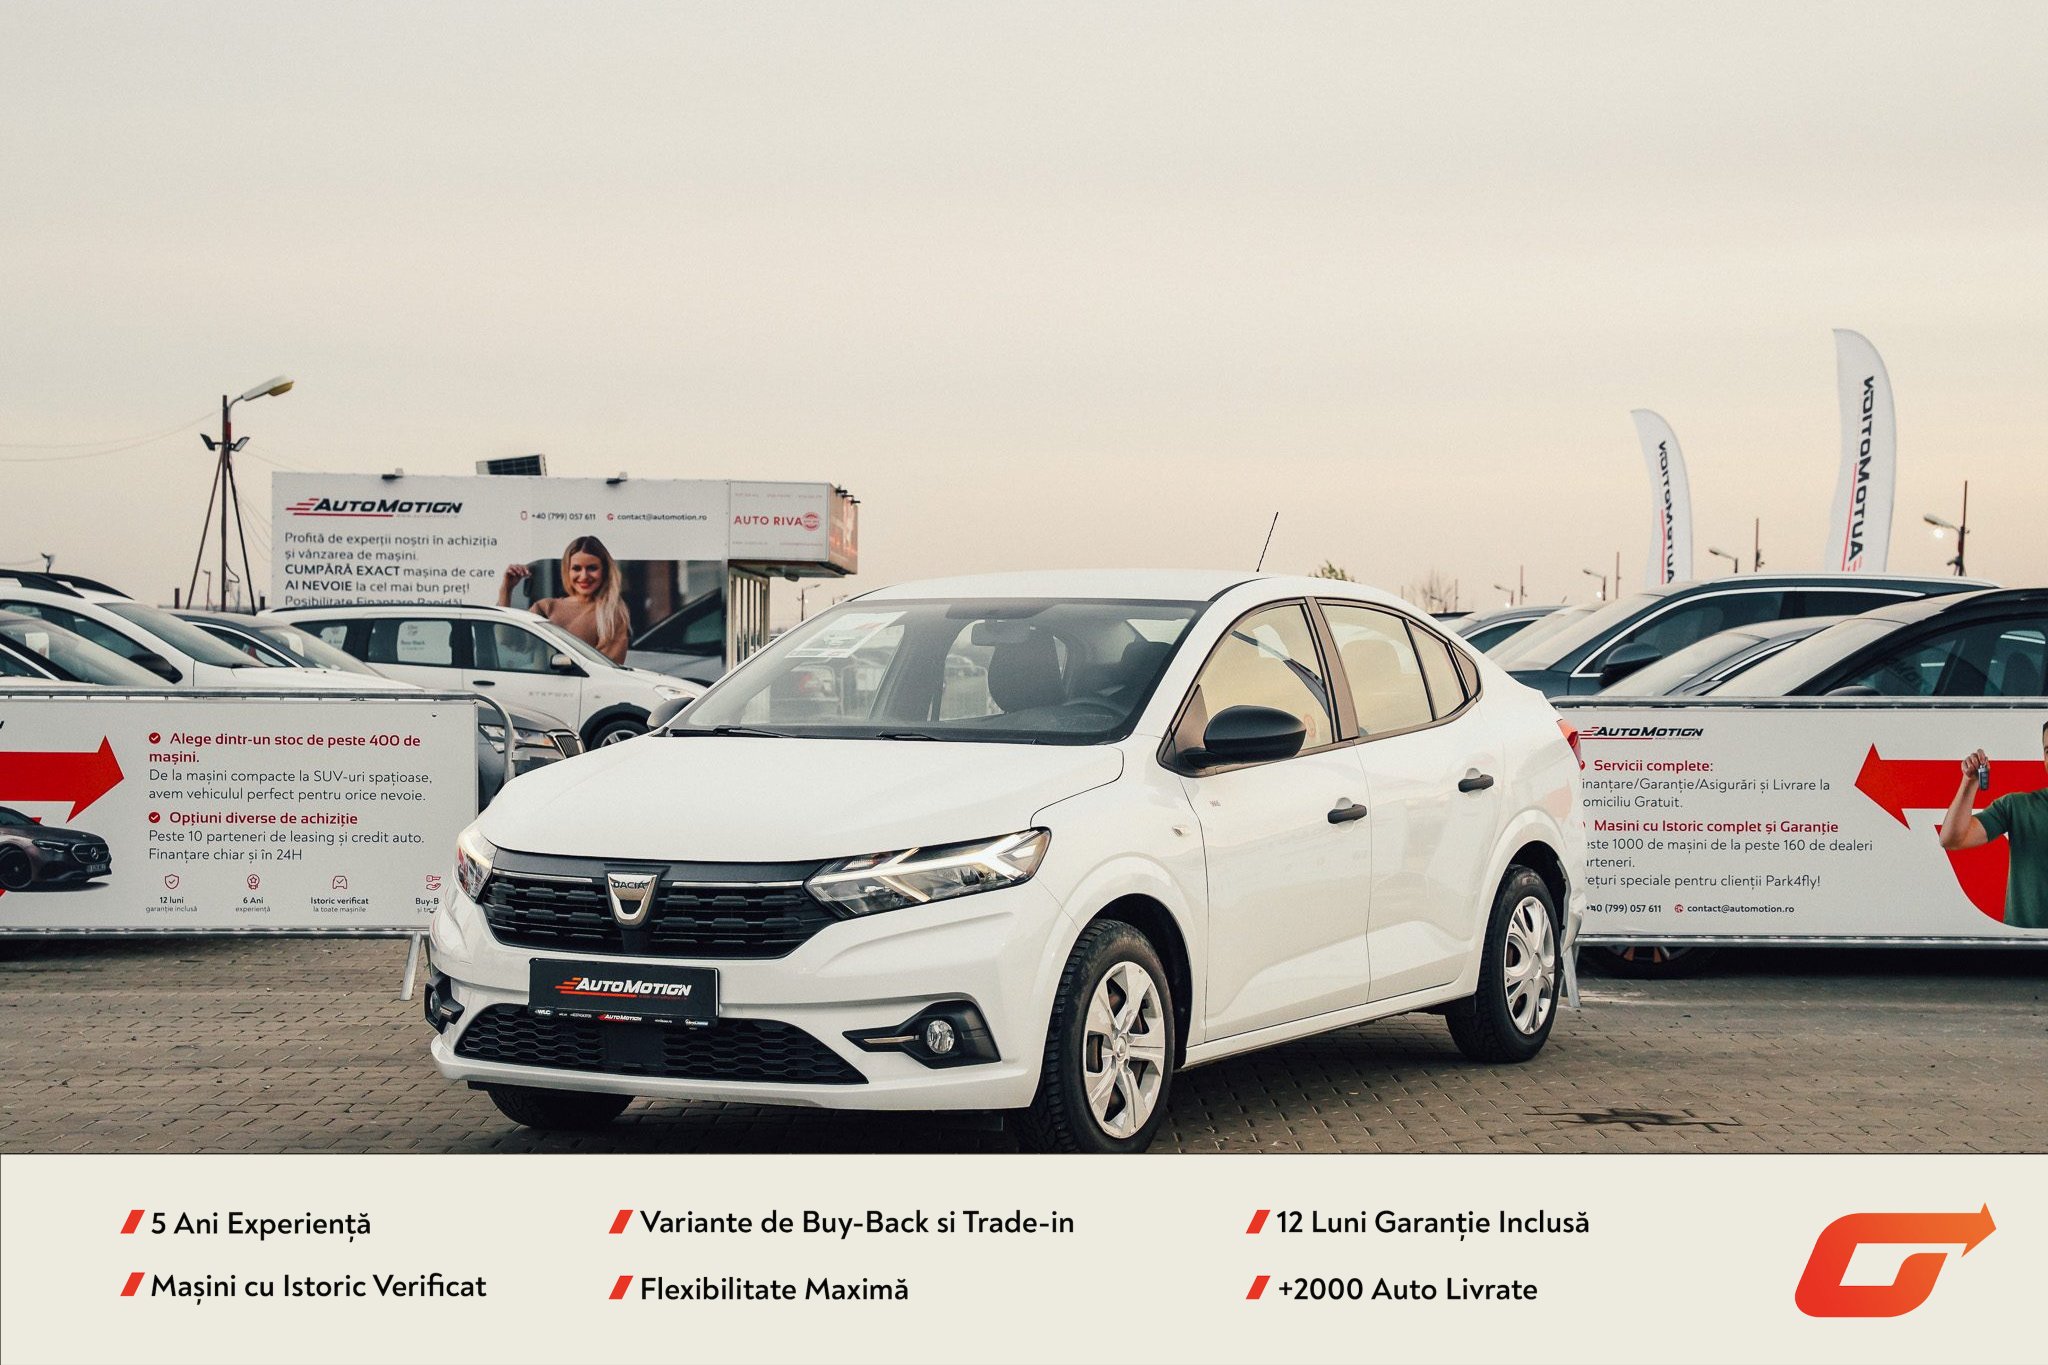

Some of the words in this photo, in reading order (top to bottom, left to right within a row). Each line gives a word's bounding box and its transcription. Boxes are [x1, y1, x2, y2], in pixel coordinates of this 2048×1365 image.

[734, 516, 769, 525] AUTO
[774, 517, 803, 526] RIVA
[328, 534, 342, 543] de
[357, 550, 372, 560] de
[357, 566, 400, 576] EXACT
[451, 568, 466, 577] de
[469, 569, 494, 577] care
[285, 580, 298, 590] AI
[302, 581, 351, 591] NEVOIE
[356, 582, 366, 591] la
[370, 582, 387, 592] cel
[391, 584, 412, 592] mai
[416, 583, 439, 592] bun
[170, 733, 211, 747] Alege
[216, 734, 270, 745] dintr-un
[275, 736, 303, 745] stoc
[307, 734, 323, 745] de
[328, 736, 365, 748] peste
[370, 735, 399, 746] 400
[404, 735, 420, 746] de
[150, 751, 199, 765] mașini.
[1595, 760, 1642, 771] Servicii
[1647, 760, 1712, 774] complete:
[150, 769, 167, 780] De
[173, 769, 182, 781] la
[187, 770, 226, 784] mașini
[231, 772, 295, 784] compacte
[300, 770, 309, 781] la
[314, 770, 364, 782] SUV-uri
[369, 773, 432, 786] spațioase,
[1583, 778, 1755, 792] inanțare/Garanție/Asigurări
[1774, 779, 1816, 790] Livrare
[1820, 779, 1829, 790] la
[187, 787, 242, 799] vehiculul
[248, 788, 294, 802] perfect
[299, 790, 340, 802] pentru
[345, 792, 376, 800] orice
[381, 790, 425, 800] nevoie.
[1583, 796, 1630, 807] omiciliu
[1635, 796, 1683, 807] Gratuit.
[170, 812, 221, 826] Opțiuni
[226, 812, 276, 823] diverse
[280, 813, 296, 823] de
[301, 813, 357, 827] achiziție
[1643, 823, 1658, 831] cu
[1663, 820, 1703, 831] Istoric
[1707, 821, 1761, 834] complet
[1781, 821, 1838, 835] Garanție
[150, 830, 184, 841] Peste
[189, 831, 202, 841] 10
[207, 831, 265, 844] parteneri
[270, 831, 286, 842] de
[291, 830, 334, 845] leasing
[352, 831, 389, 842] credit
[393, 833, 424, 843] auto.
[1588, 837, 1609, 850] ste
[1613, 839, 1643, 849] 1000
[1648, 838, 1663, 849] de
[1668, 839, 1706, 853] mașini
[1711, 839, 1726, 850] de
[1731, 839, 1740, 850] la
[1745, 841, 1779, 853] peste
[1784, 840, 1805, 850] 160
[1810, 839, 1825, 850] de
[1830, 839, 1872, 851] dealeri
[150, 848, 209, 863] Finanțare
[214, 848, 244, 860] chiar
[261, 849, 272, 860] în
[277, 849, 301, 860] 24H
[1586, 857, 1635, 868] rteneri.
[613, 880, 646, 889] DACIA
[1585, 874, 1616, 889] ețuri
[1621, 874, 1670, 888] speciale
[1675, 876, 1716, 888] pentru
[1767, 875, 1820, 889] Park4fly!
[1605, 904, 1627, 913] (799)
[1688, 905, 1794, 913] contact@automotion.ro
